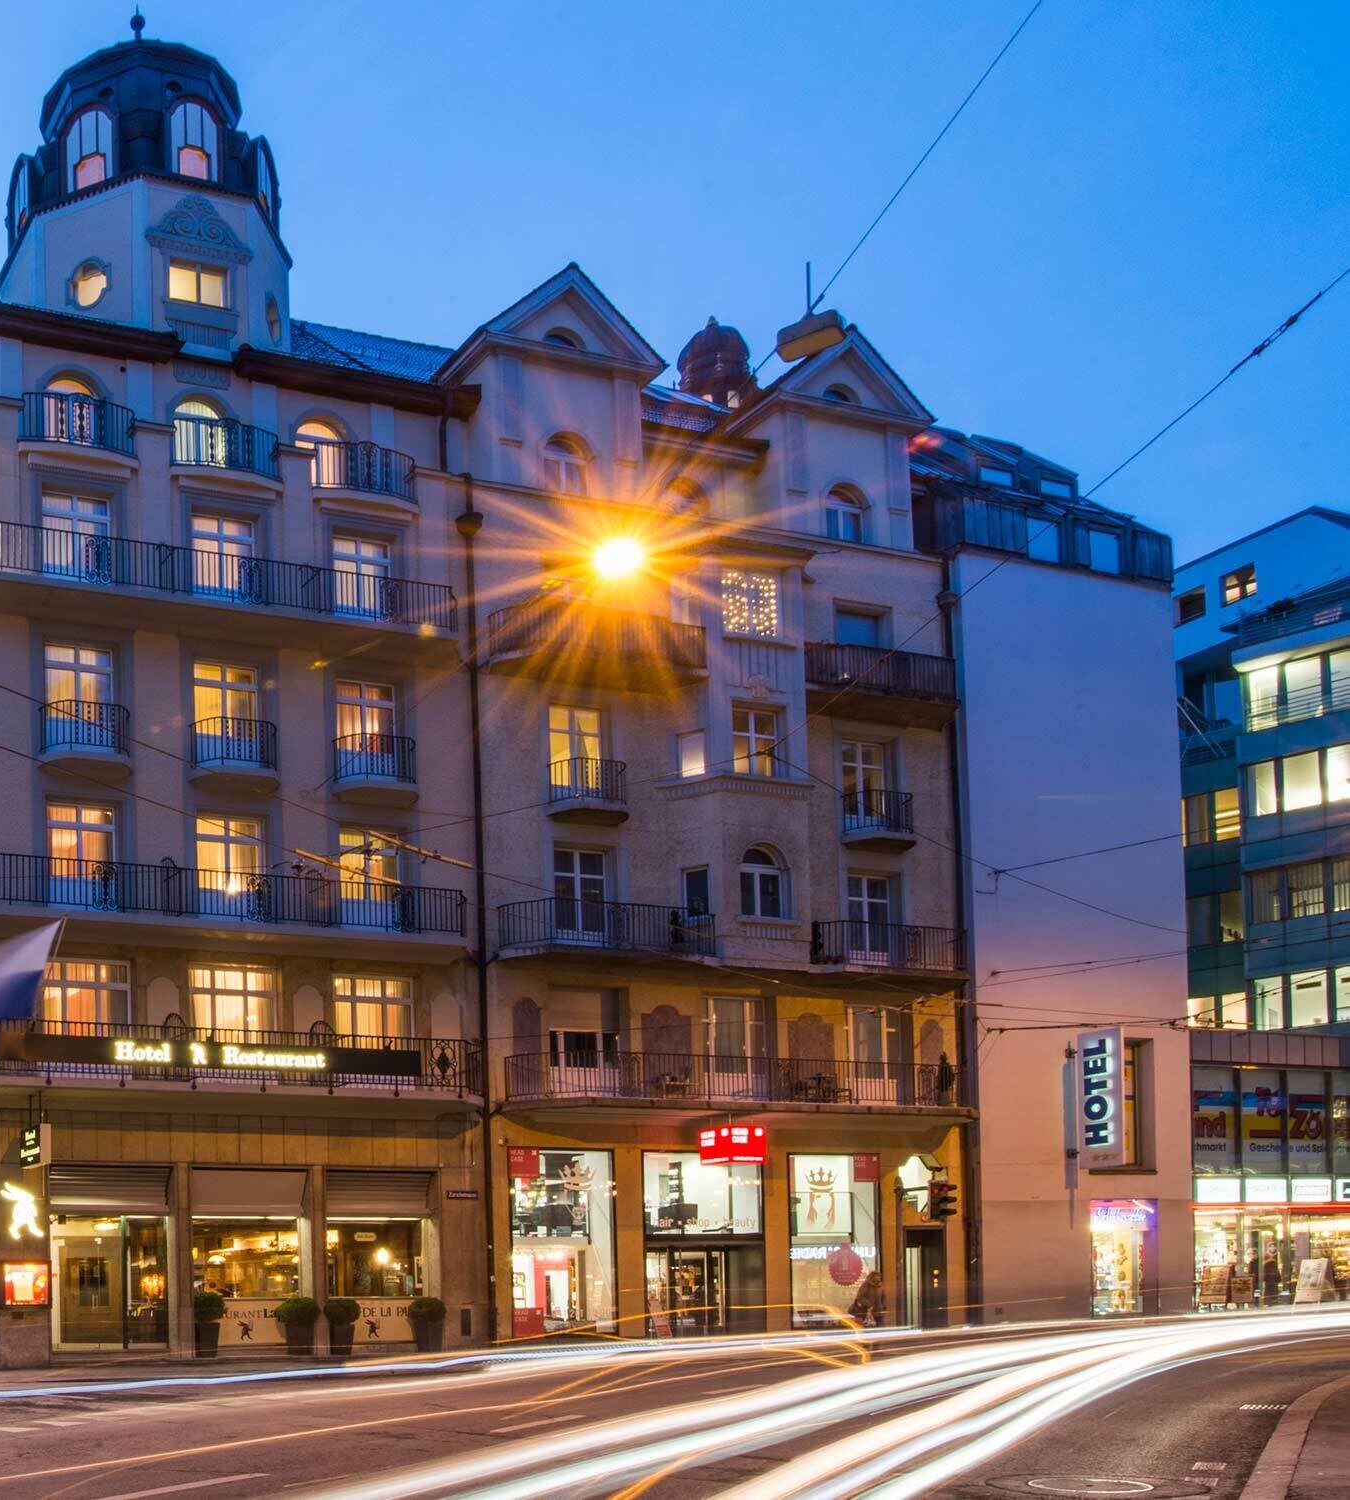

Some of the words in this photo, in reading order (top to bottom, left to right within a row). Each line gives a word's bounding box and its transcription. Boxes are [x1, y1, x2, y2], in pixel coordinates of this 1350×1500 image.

[114, 1041, 171, 1063] Hotel
[222, 1045, 326, 1068] Restaurant
[1083, 1038, 1109, 1146] HOTEL
[1296, 1143, 1310, 1153] und
[362, 1306, 377, 1318] DE
[380, 1306, 392, 1317] LA
